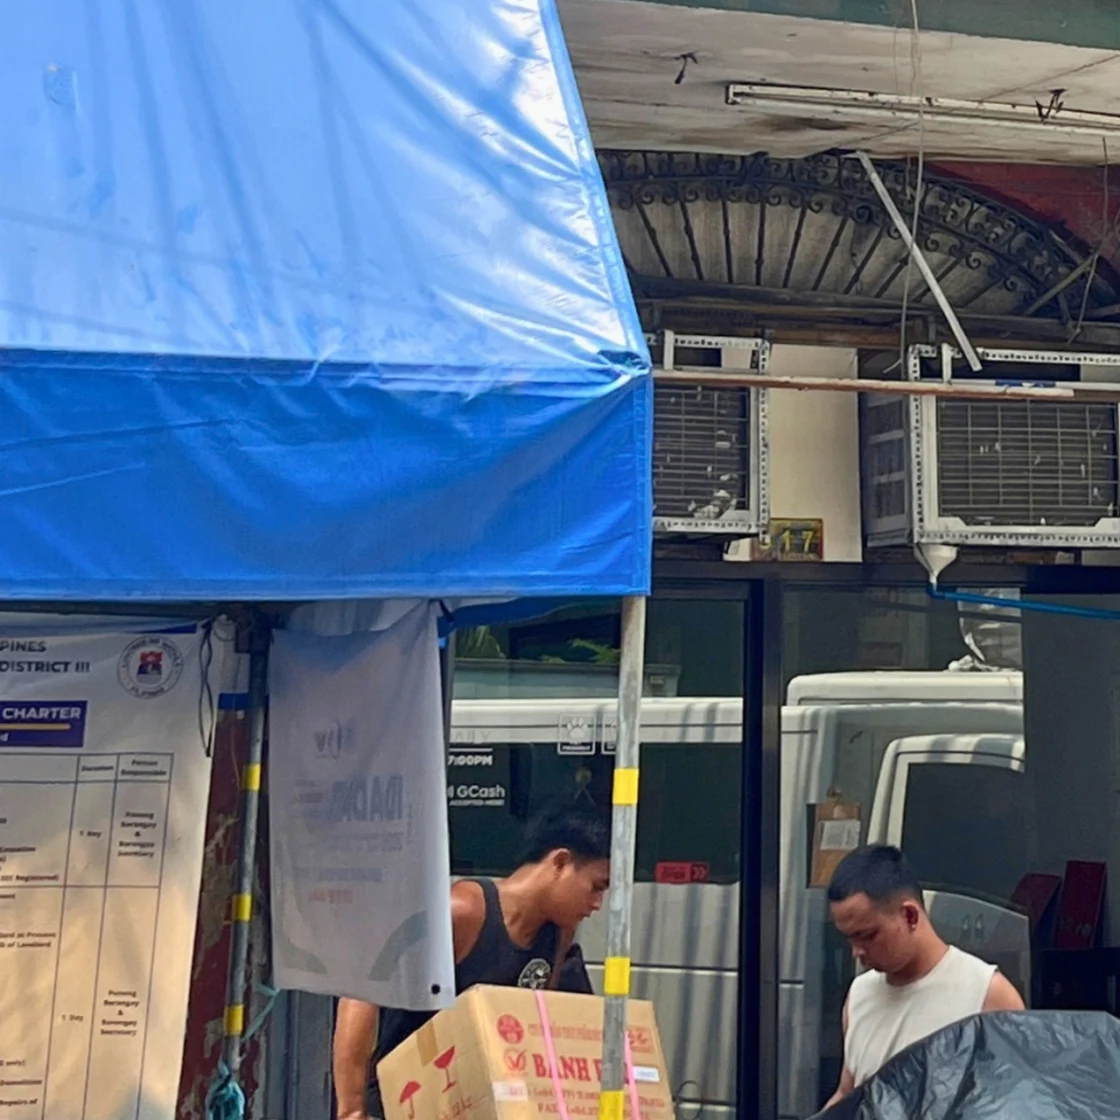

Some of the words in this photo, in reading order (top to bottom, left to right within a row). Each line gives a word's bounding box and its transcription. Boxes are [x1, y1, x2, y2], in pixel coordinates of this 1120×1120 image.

[0, 660, 71, 674] DISTRICT
[75, 660, 91, 674] III
[2, 706, 82, 720] CHARTER
[457, 784, 506, 799] GCash
